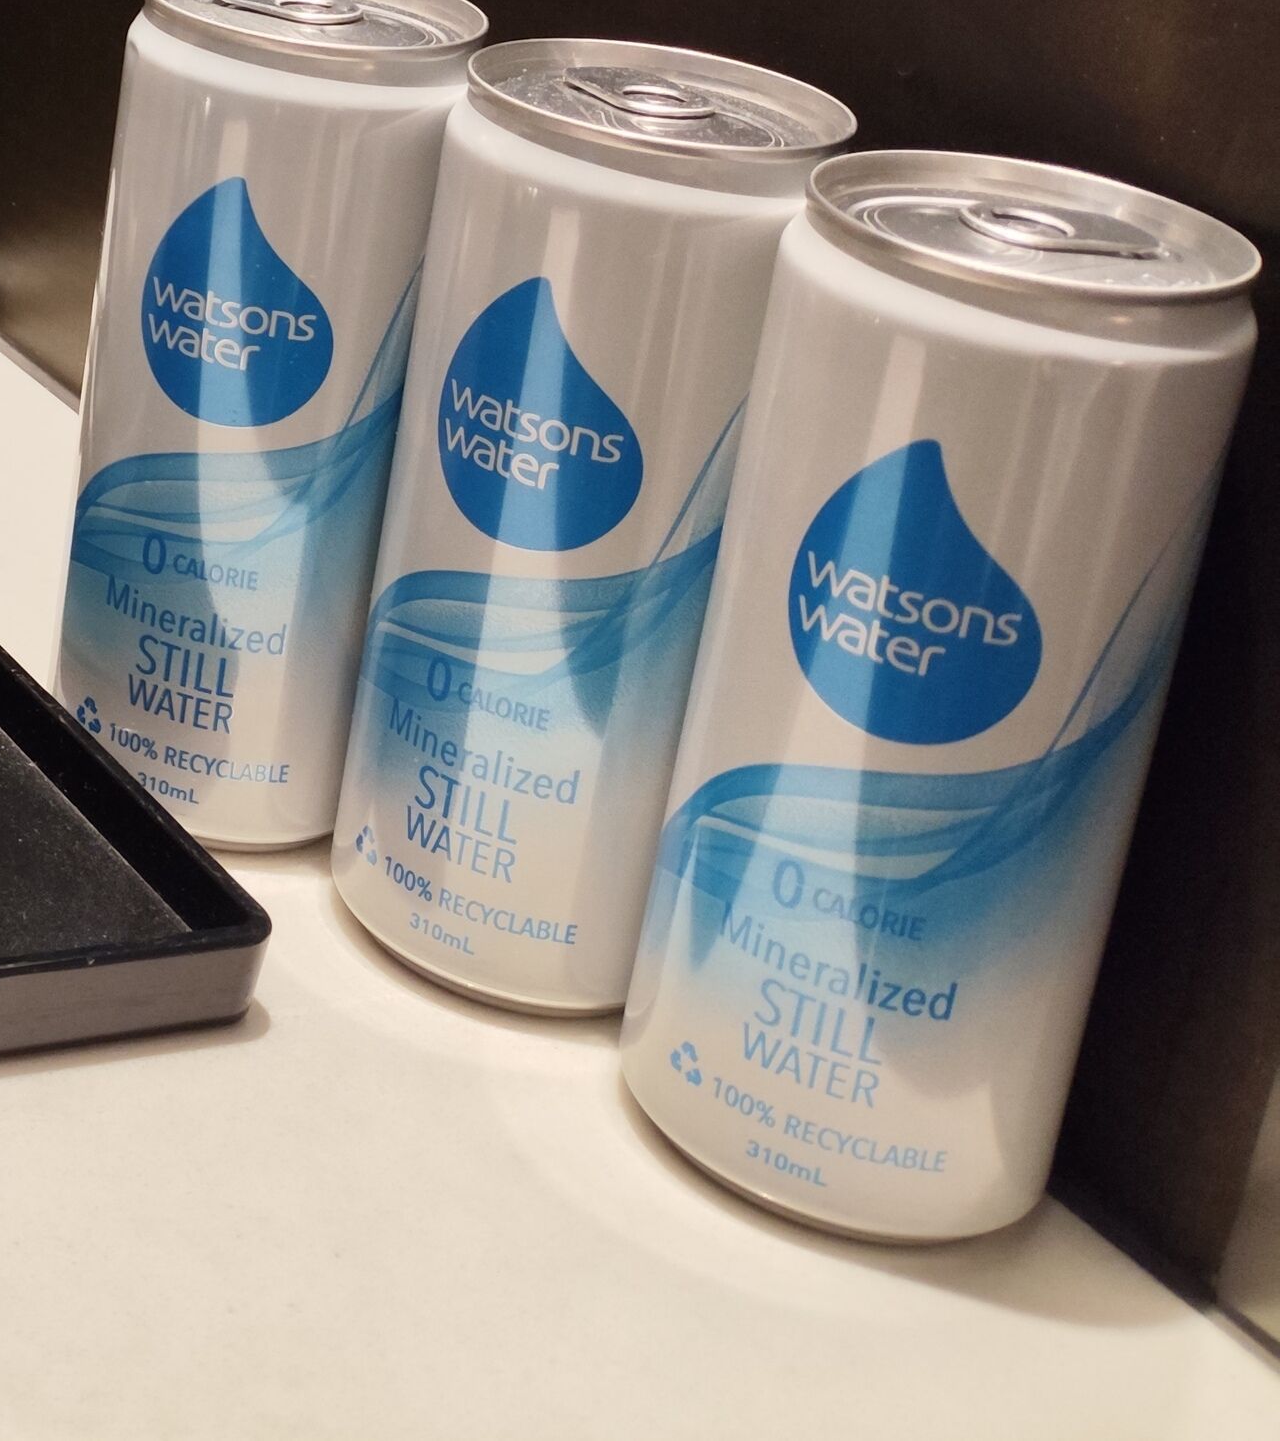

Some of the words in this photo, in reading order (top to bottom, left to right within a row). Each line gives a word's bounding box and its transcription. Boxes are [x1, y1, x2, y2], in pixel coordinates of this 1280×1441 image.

[148, 313, 261, 371] water
[153, 276, 317, 342] watsons
[445, 417, 560, 490] water
[452, 378, 624, 463] watsons
[142, 533, 167, 575] 0
[174, 554, 259, 590] CALORIE
[808, 550, 1023, 646] watsons
[106, 574, 287, 655] Mineralized
[799, 594, 947, 676] water
[128, 673, 234, 734] WATER
[136, 634, 234, 699] STILL
[427, 659, 452, 701] 0
[458, 681, 551, 732] CALORIE
[109, 722, 158, 760] 100%
[164, 745, 290, 784] RECYCLABLE
[137, 771, 200, 805] 310mL
[389, 696, 581, 805] Mineralized
[406, 804, 517, 884] WATER
[414, 765, 518, 845] STILL
[384, 856, 433, 903] 100%
[439, 888, 578, 945] RECYCLABLE
[409, 912, 476, 956] 310mL
[771, 859, 806, 909] 0
[812, 887, 928, 942] CALORIE
[719, 901, 959, 1021] Mineralized
[754, 977, 882, 1066] STILL
[742, 1021, 881, 1108] WATER
[712, 1076, 776, 1129] 100%
[783, 1114, 948, 1174] RECYCLABLE
[745, 1139, 828, 1188] 310mL
